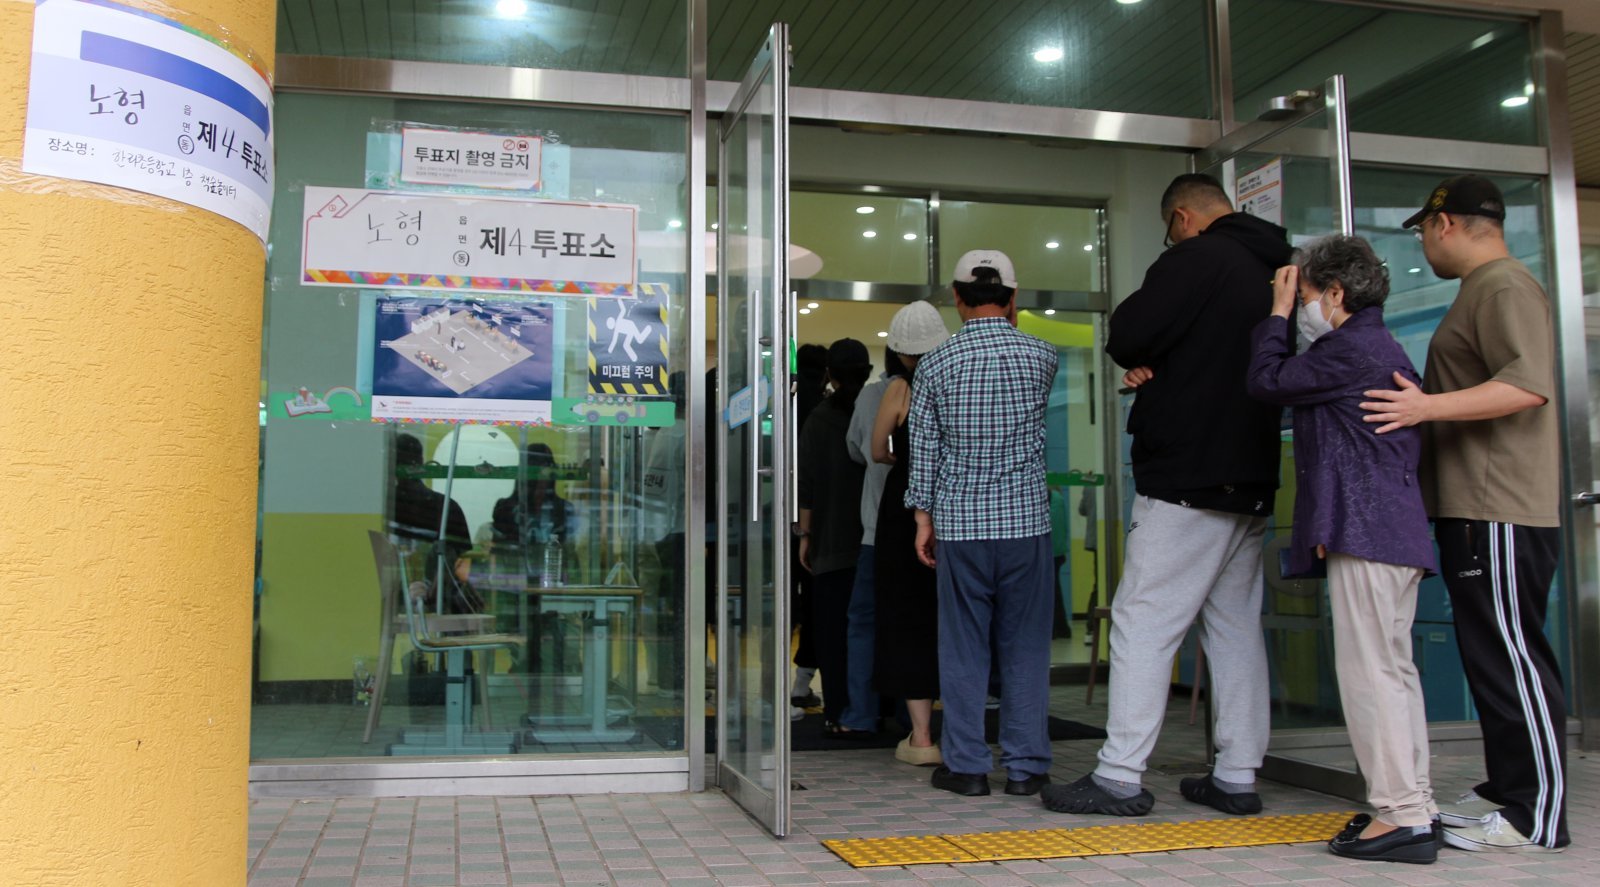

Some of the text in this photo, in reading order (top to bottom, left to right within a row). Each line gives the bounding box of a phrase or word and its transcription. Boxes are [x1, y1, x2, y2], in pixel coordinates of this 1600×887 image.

[89, 84, 145, 125] 노형
[112, 149, 176, 176] 한라초등학교
[414, 147, 529, 170] 투표지 촬영 금지
[368, 210, 422, 246] 노형
[602, 364, 654, 379] 미끄럼 주의
